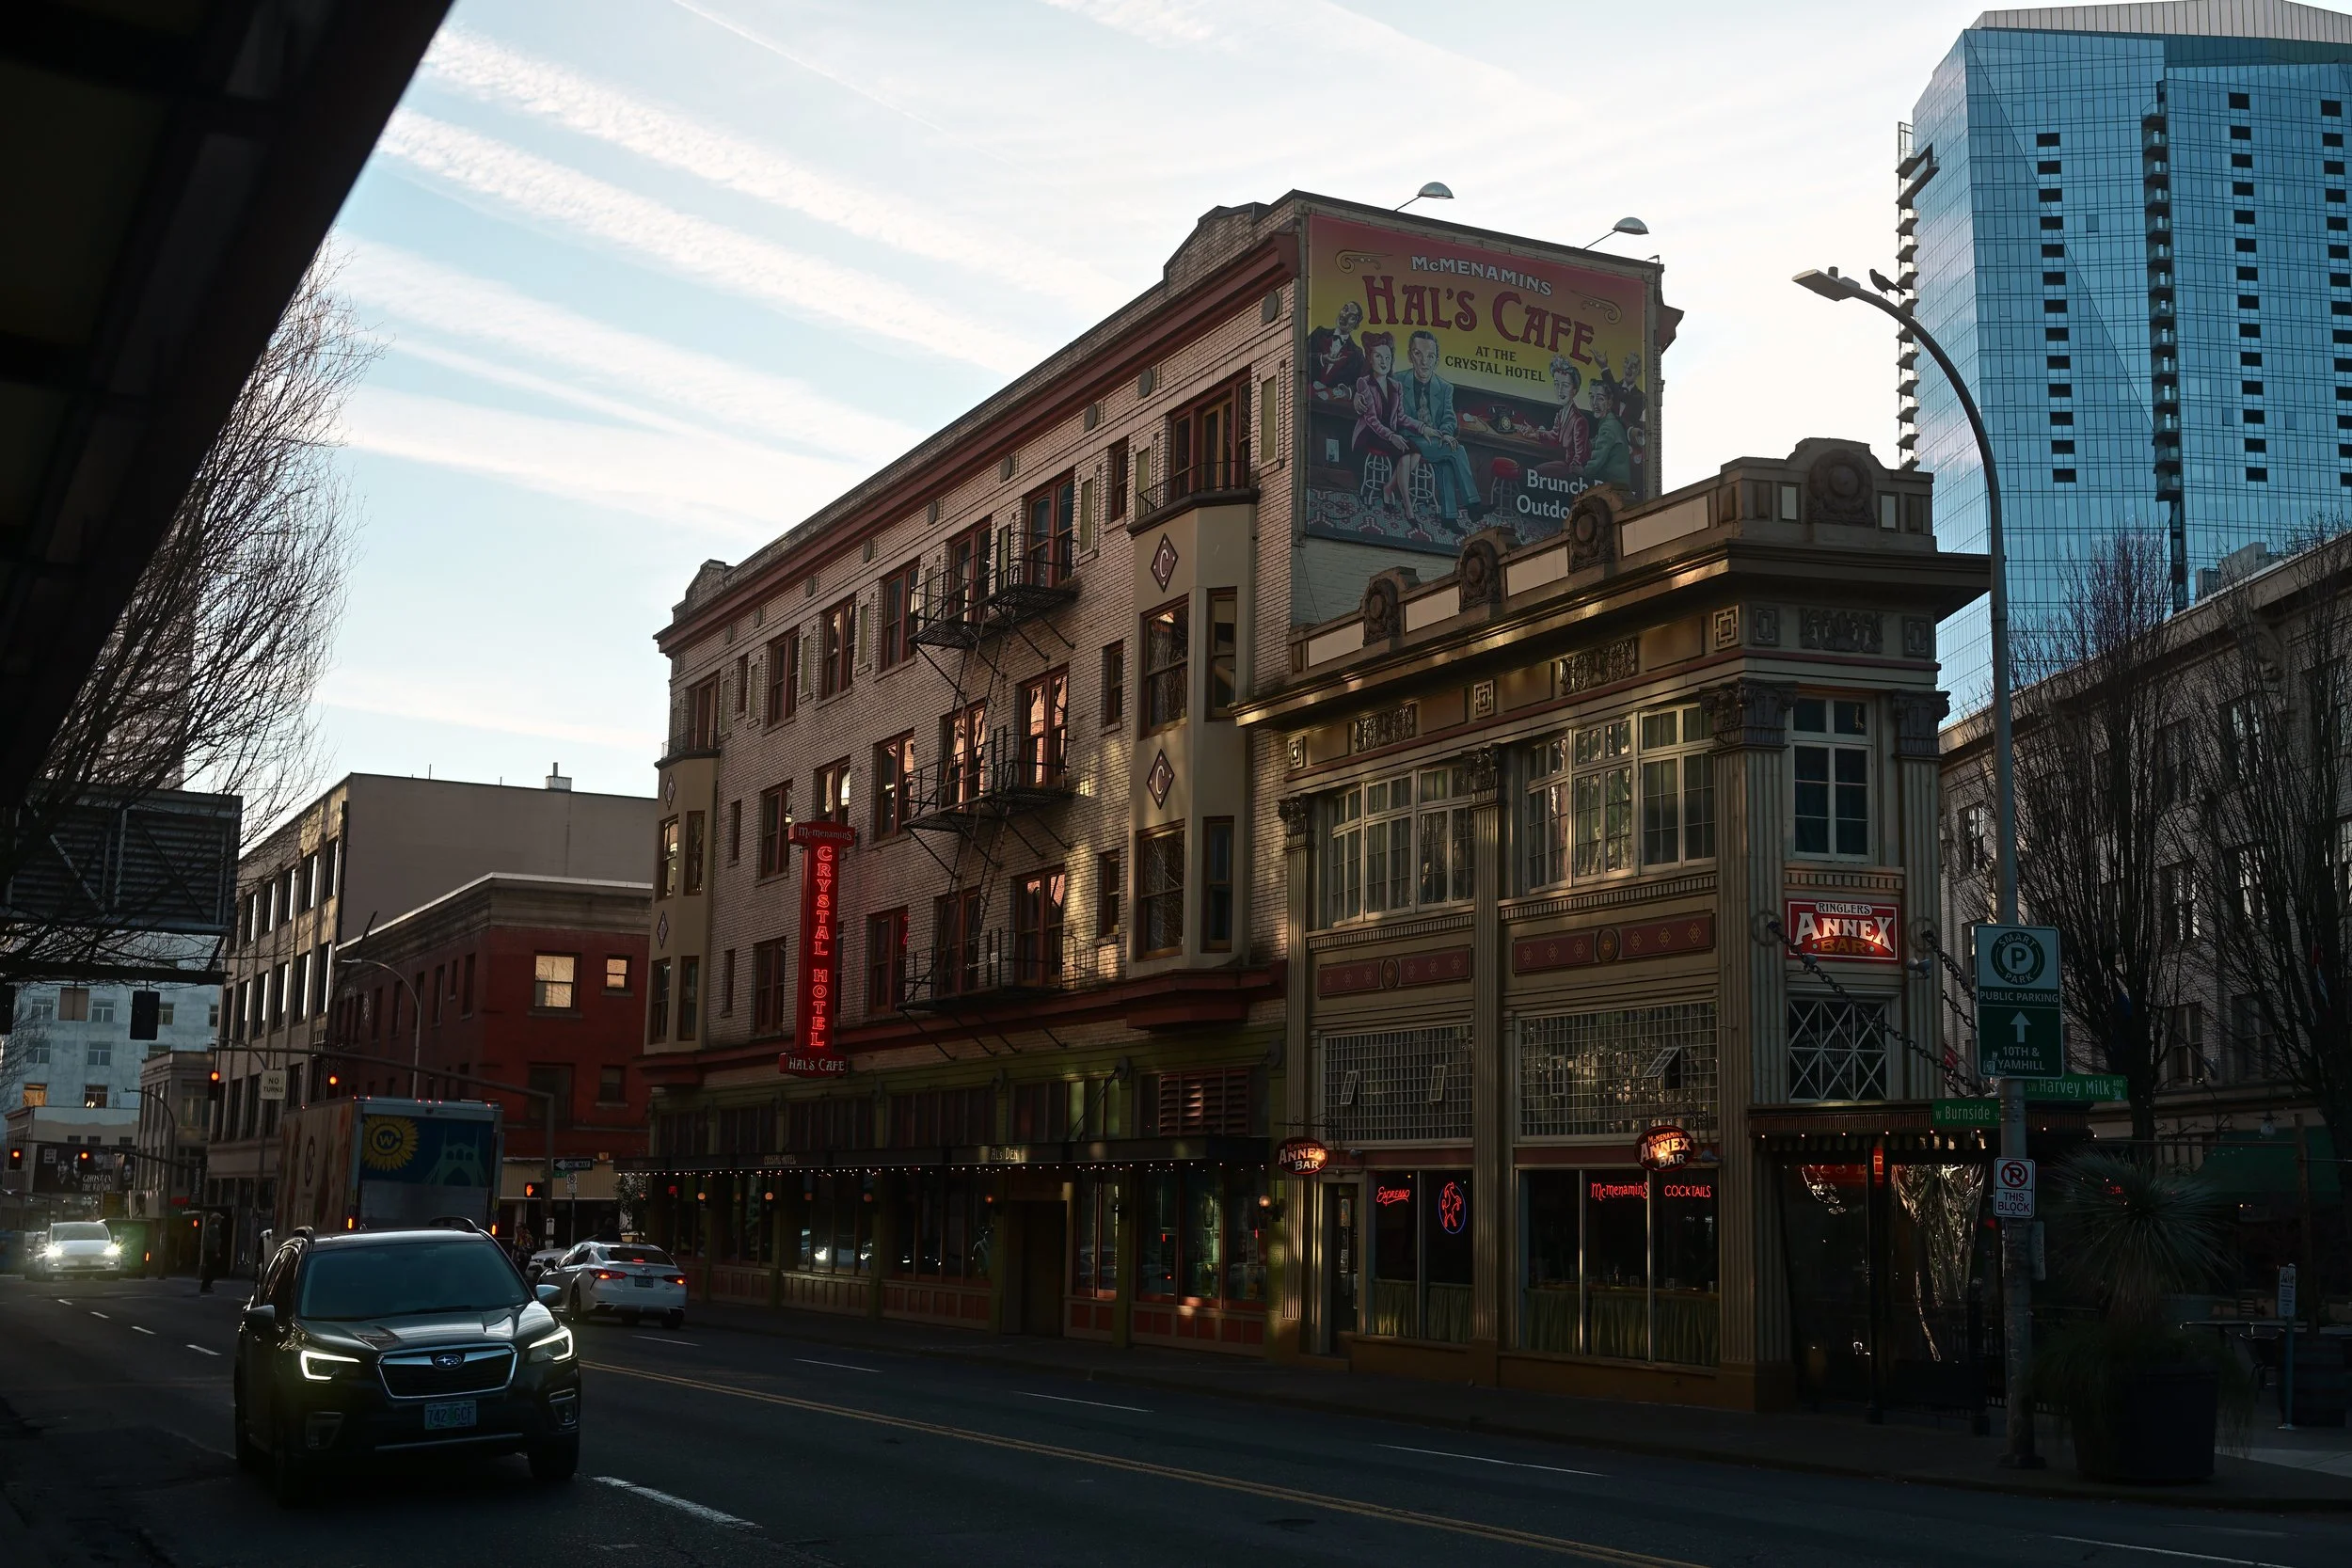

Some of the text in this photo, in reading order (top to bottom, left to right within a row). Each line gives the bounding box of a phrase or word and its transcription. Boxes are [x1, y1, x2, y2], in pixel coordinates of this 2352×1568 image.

[1362, 276, 1594, 365] HAL'S CAFE
[1475, 346, 1517, 362] AT THE
[1445, 356, 1546, 382] CRYSTAL HOTEL
[1527, 468, 1588, 495] Brunch
[1819, 903, 1870, 915] RINGLERS
[1793, 912, 1894, 954] ANNEX
[1998, 932, 2037, 947] SMART
[811, 847, 833, 1046] CRYSTAL HOTEL
[1820, 939, 1867, 954] BAR
[2004, 973, 2034, 984] PARK
[1979, 990, 2059, 1004] PUBLIC PARKING
[2002, 1046, 2040, 1057] 10TH &
[818, 1058, 846, 1071] CAFE
[1997, 1060, 2045, 1071] YAMHILL
[2039, 1078, 2080, 1101] Harvey
[2086, 1080, 2110, 1095] Milk
[1945, 1106, 1991, 1120] Burnside
[1640, 1137, 1692, 1163] ANNEX
[1295, 1160, 1319, 1171] BAR
[1659, 1154, 1686, 1168] BAR
[1664, 1185, 1711, 1198] COCKTAILS
[2003, 1192, 2025, 1202] THIS
[1997, 1201, 2030, 1212] BLOCK
